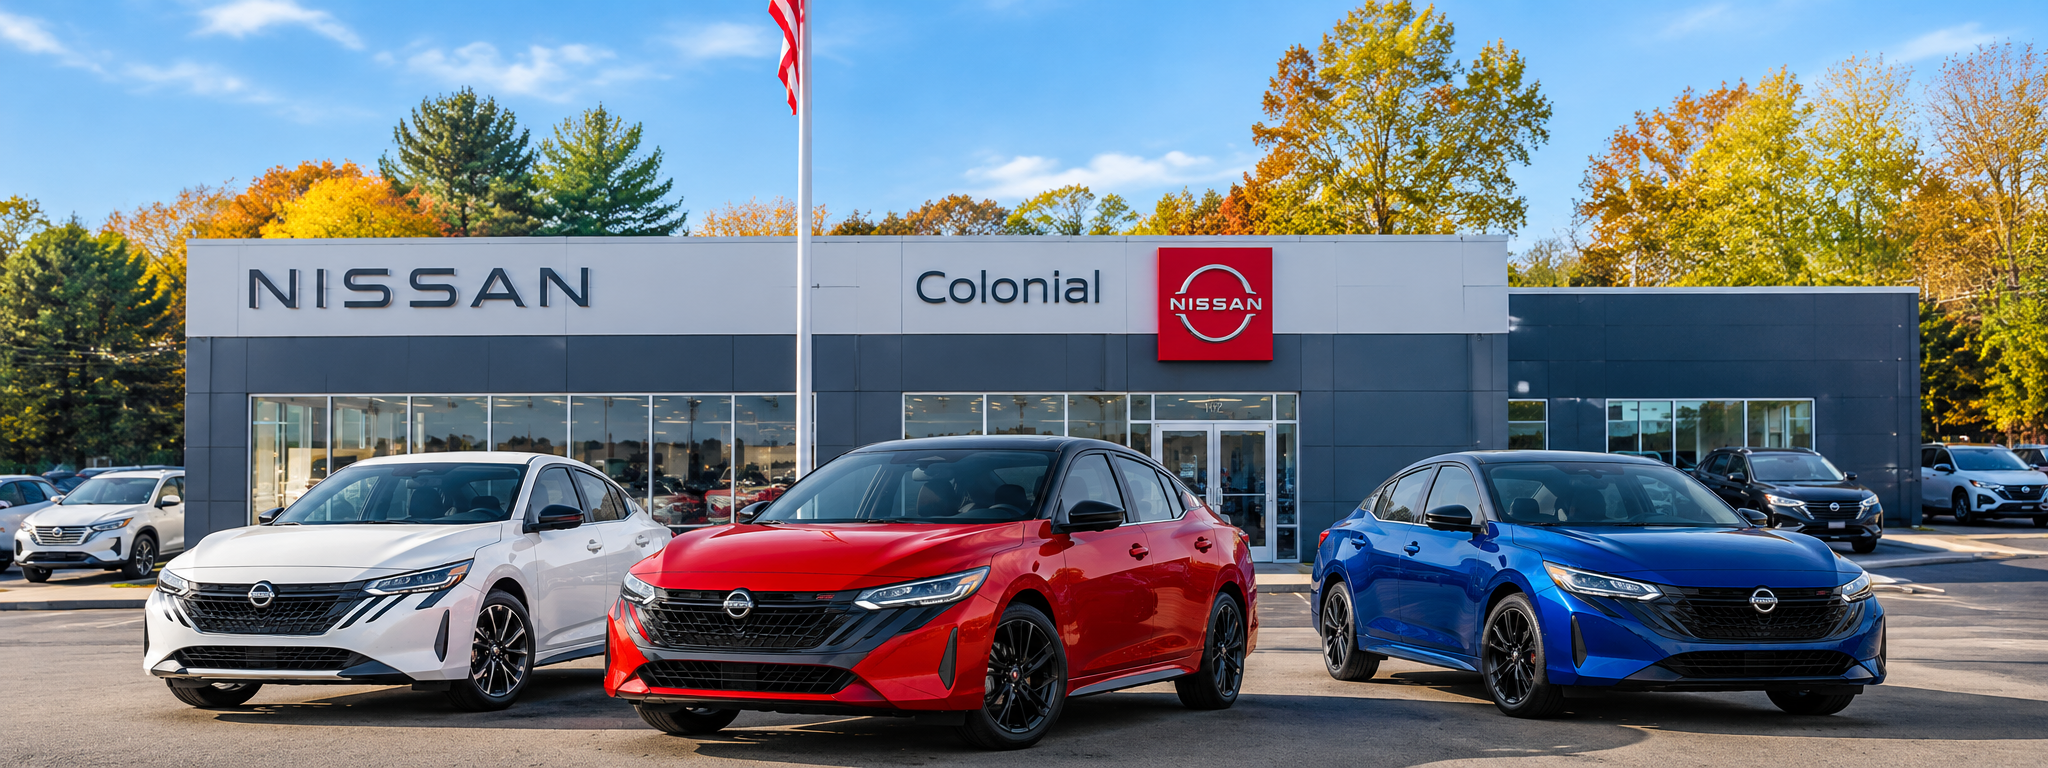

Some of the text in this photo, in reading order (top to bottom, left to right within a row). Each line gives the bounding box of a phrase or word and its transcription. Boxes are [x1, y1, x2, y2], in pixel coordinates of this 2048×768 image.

[248, 267, 592, 309] NISSAN
[916, 269, 1100, 303] Colonial
[1170, 298, 1262, 310] NISSAN
